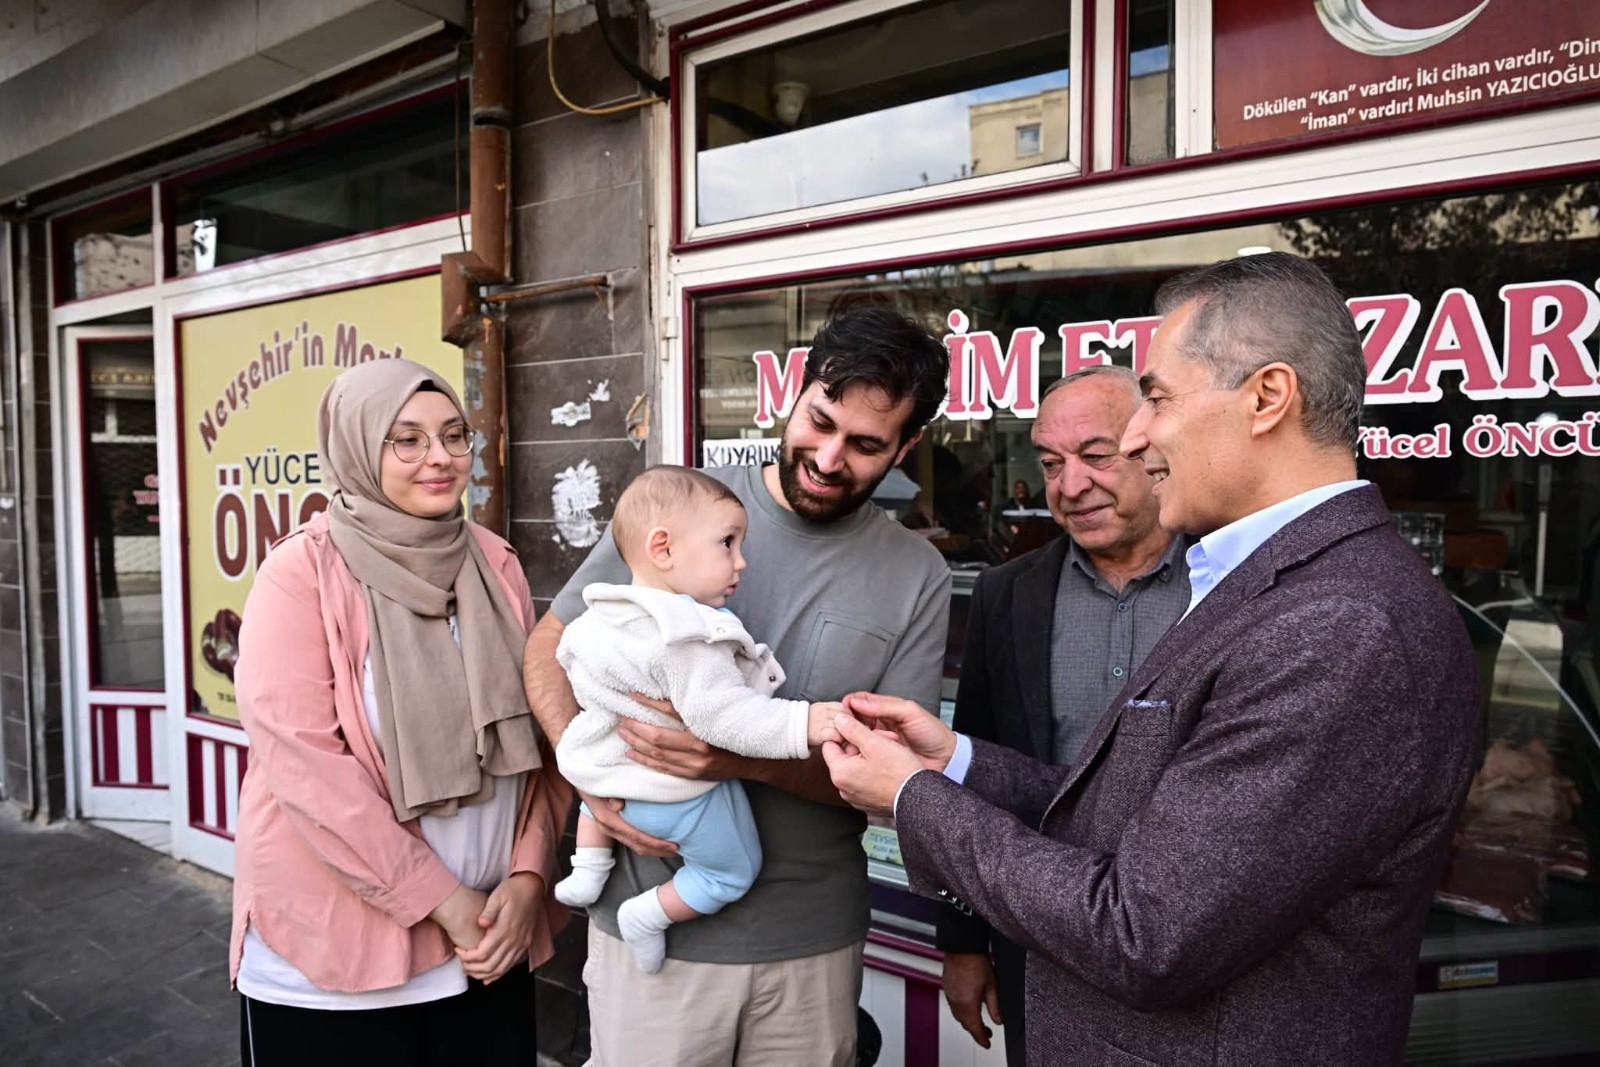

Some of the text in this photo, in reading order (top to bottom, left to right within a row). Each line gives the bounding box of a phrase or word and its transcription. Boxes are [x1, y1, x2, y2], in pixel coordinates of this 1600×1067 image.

[1243, 96, 1307, 120] Dökülen
[1310, 84, 1356, 106] “Kan”
[1359, 75, 1413, 98] vardır,
[1416, 67, 1438, 87] İki
[1442, 61, 1490, 82] cihan
[1494, 48, 1554, 71] vardır,
[1300, 63, 1600, 131] “İman” vardır! Muhsin YAZICIOĞLU
[1346, 279, 1600, 405] ZAR
[245, 447, 322, 486] YÜCE
